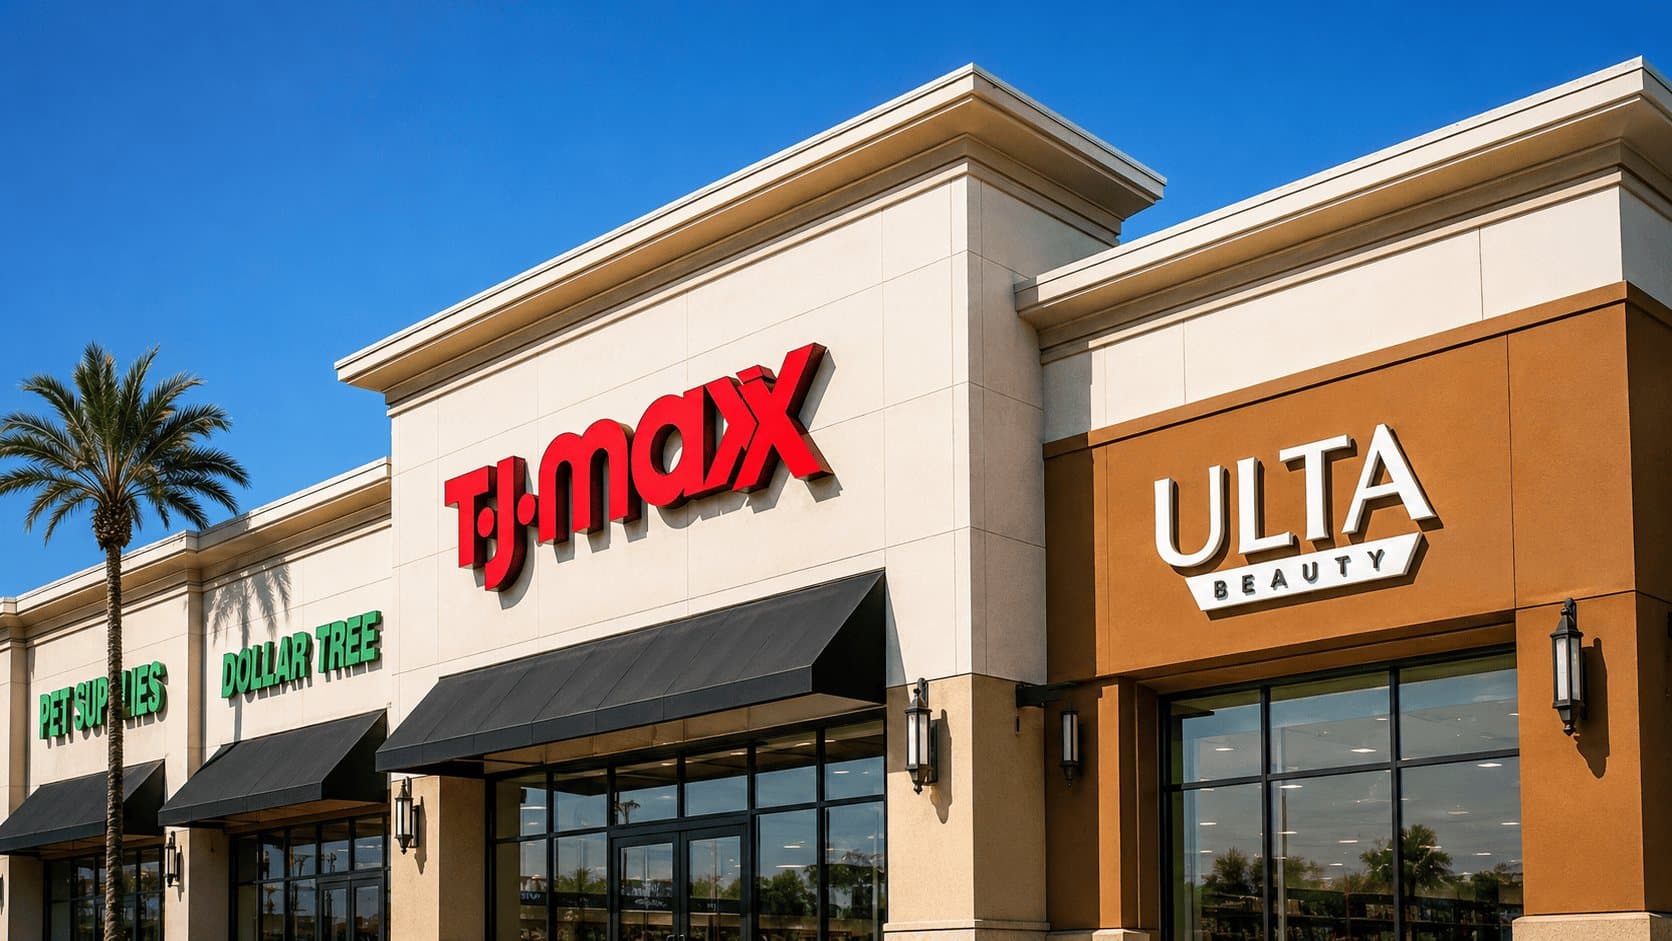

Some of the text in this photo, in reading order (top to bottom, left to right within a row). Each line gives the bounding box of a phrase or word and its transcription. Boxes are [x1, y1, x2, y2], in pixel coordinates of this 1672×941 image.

[1153, 423, 1436, 567] ULTA
[1213, 549, 1385, 600] BEAUTY
[221, 610, 382, 698] DOLLAR TREE
[39, 686, 74, 739] PET
